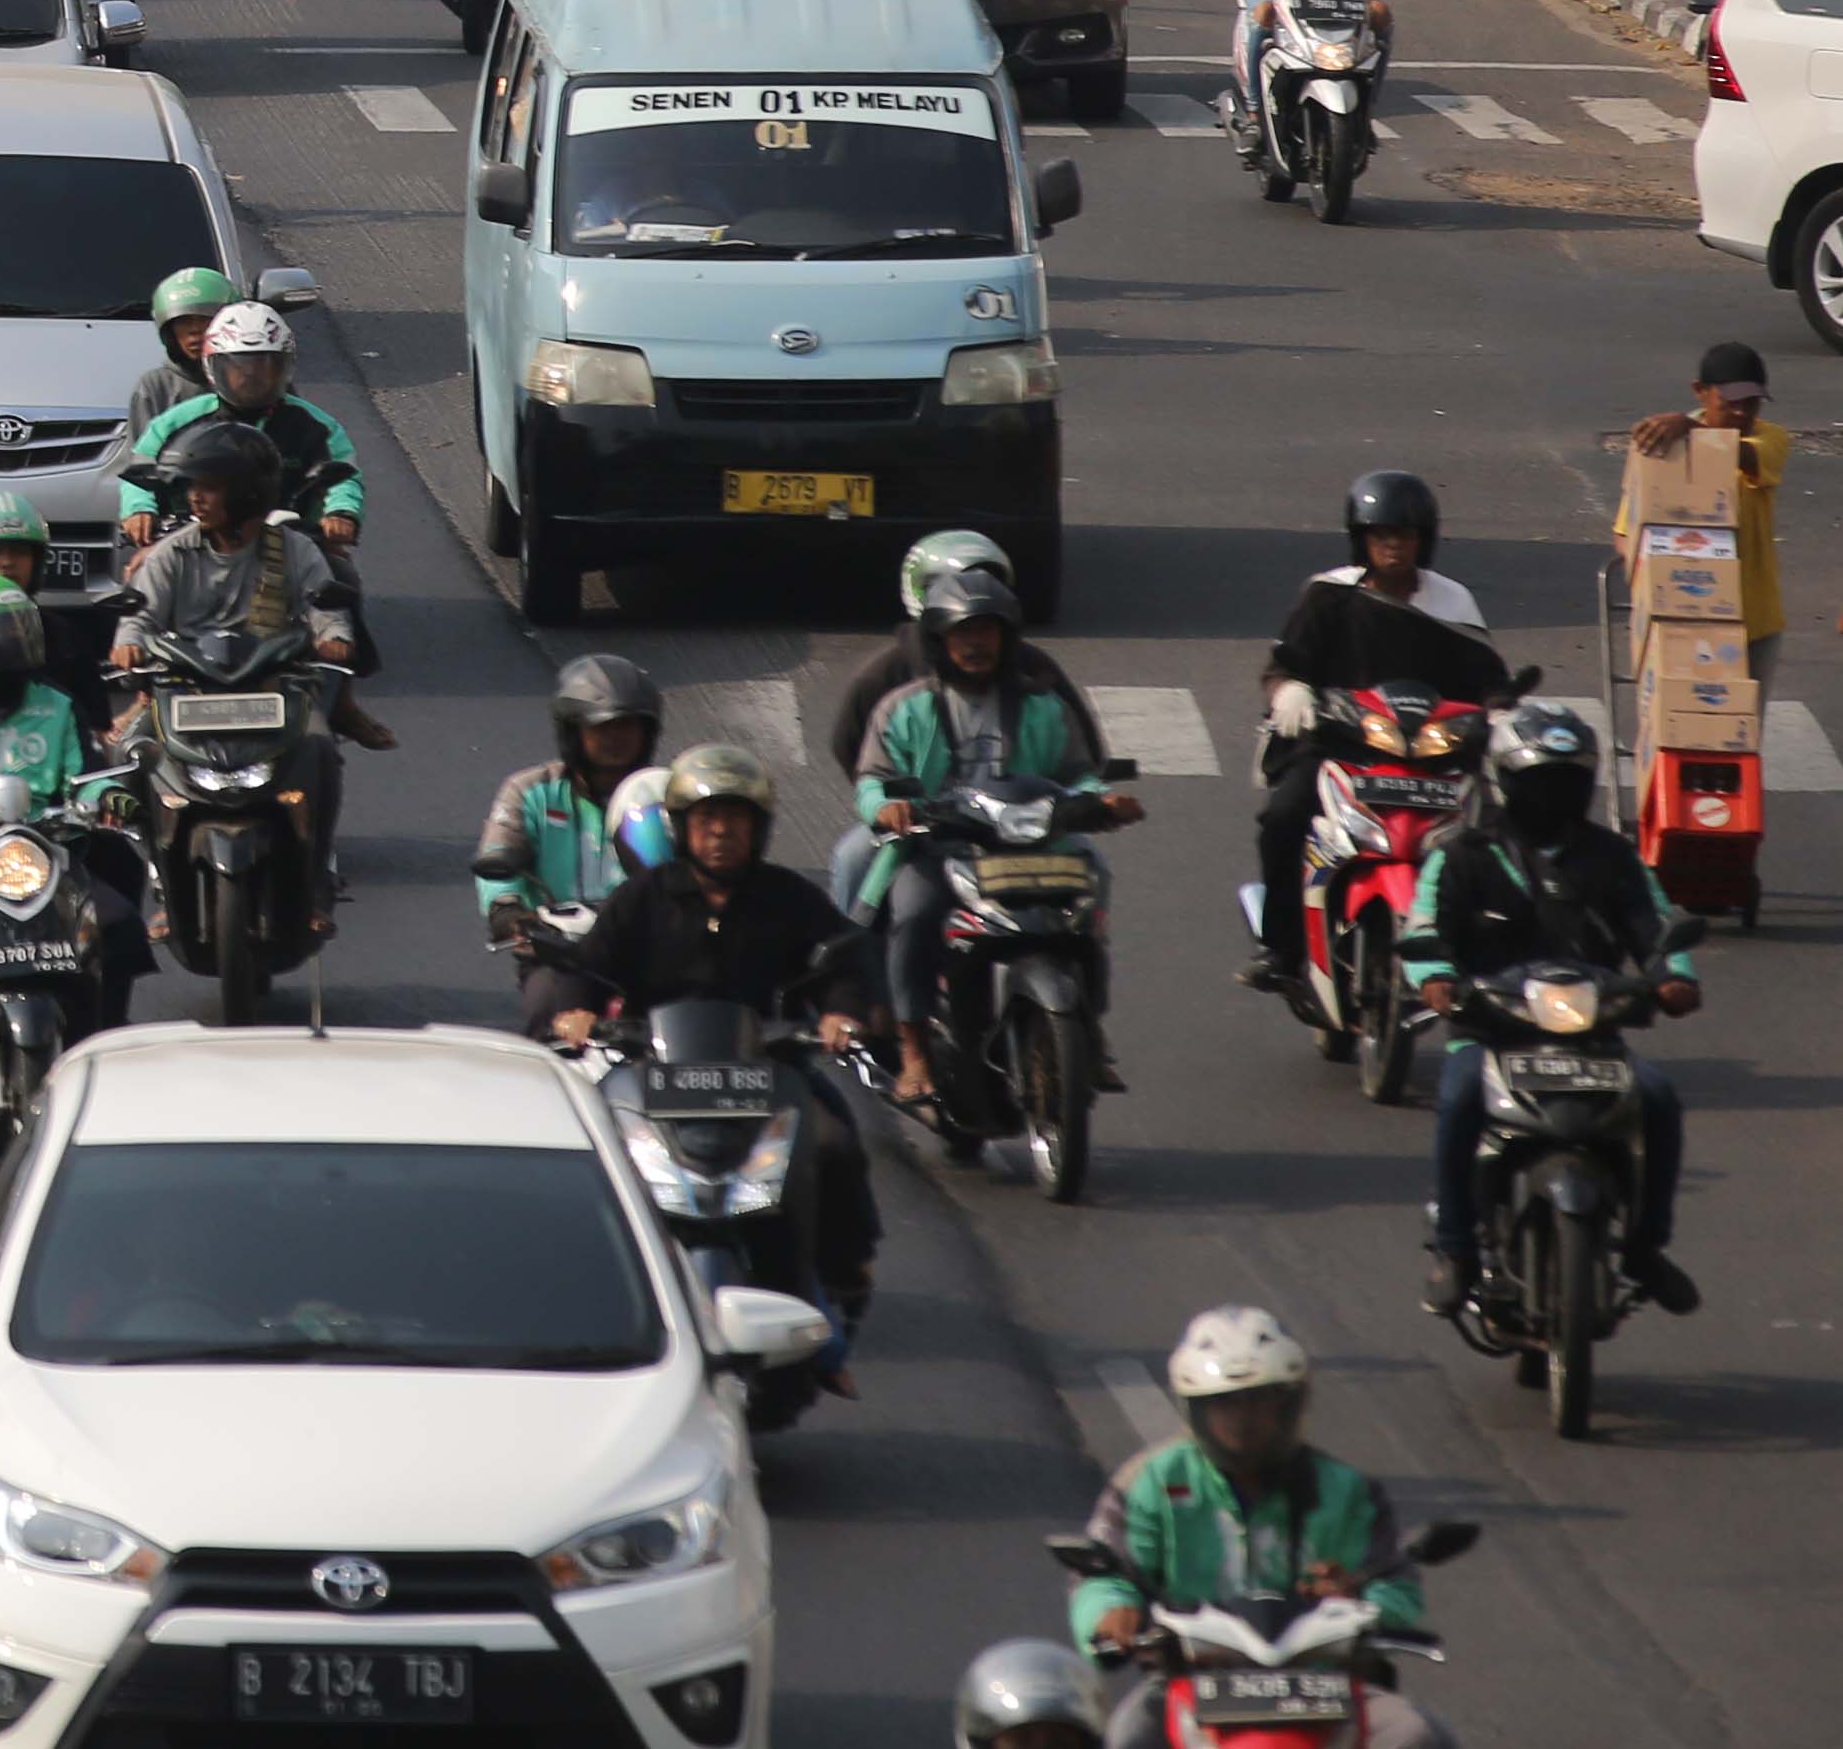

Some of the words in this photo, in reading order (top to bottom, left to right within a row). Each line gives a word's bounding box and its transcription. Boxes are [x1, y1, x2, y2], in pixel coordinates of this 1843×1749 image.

[631, 92, 732, 112] SENEN
[759, 90, 804, 115] 01
[856, 92, 962, 115] MELAYU
[755, 120, 812, 150] 01
[726, 472, 740, 502] B
